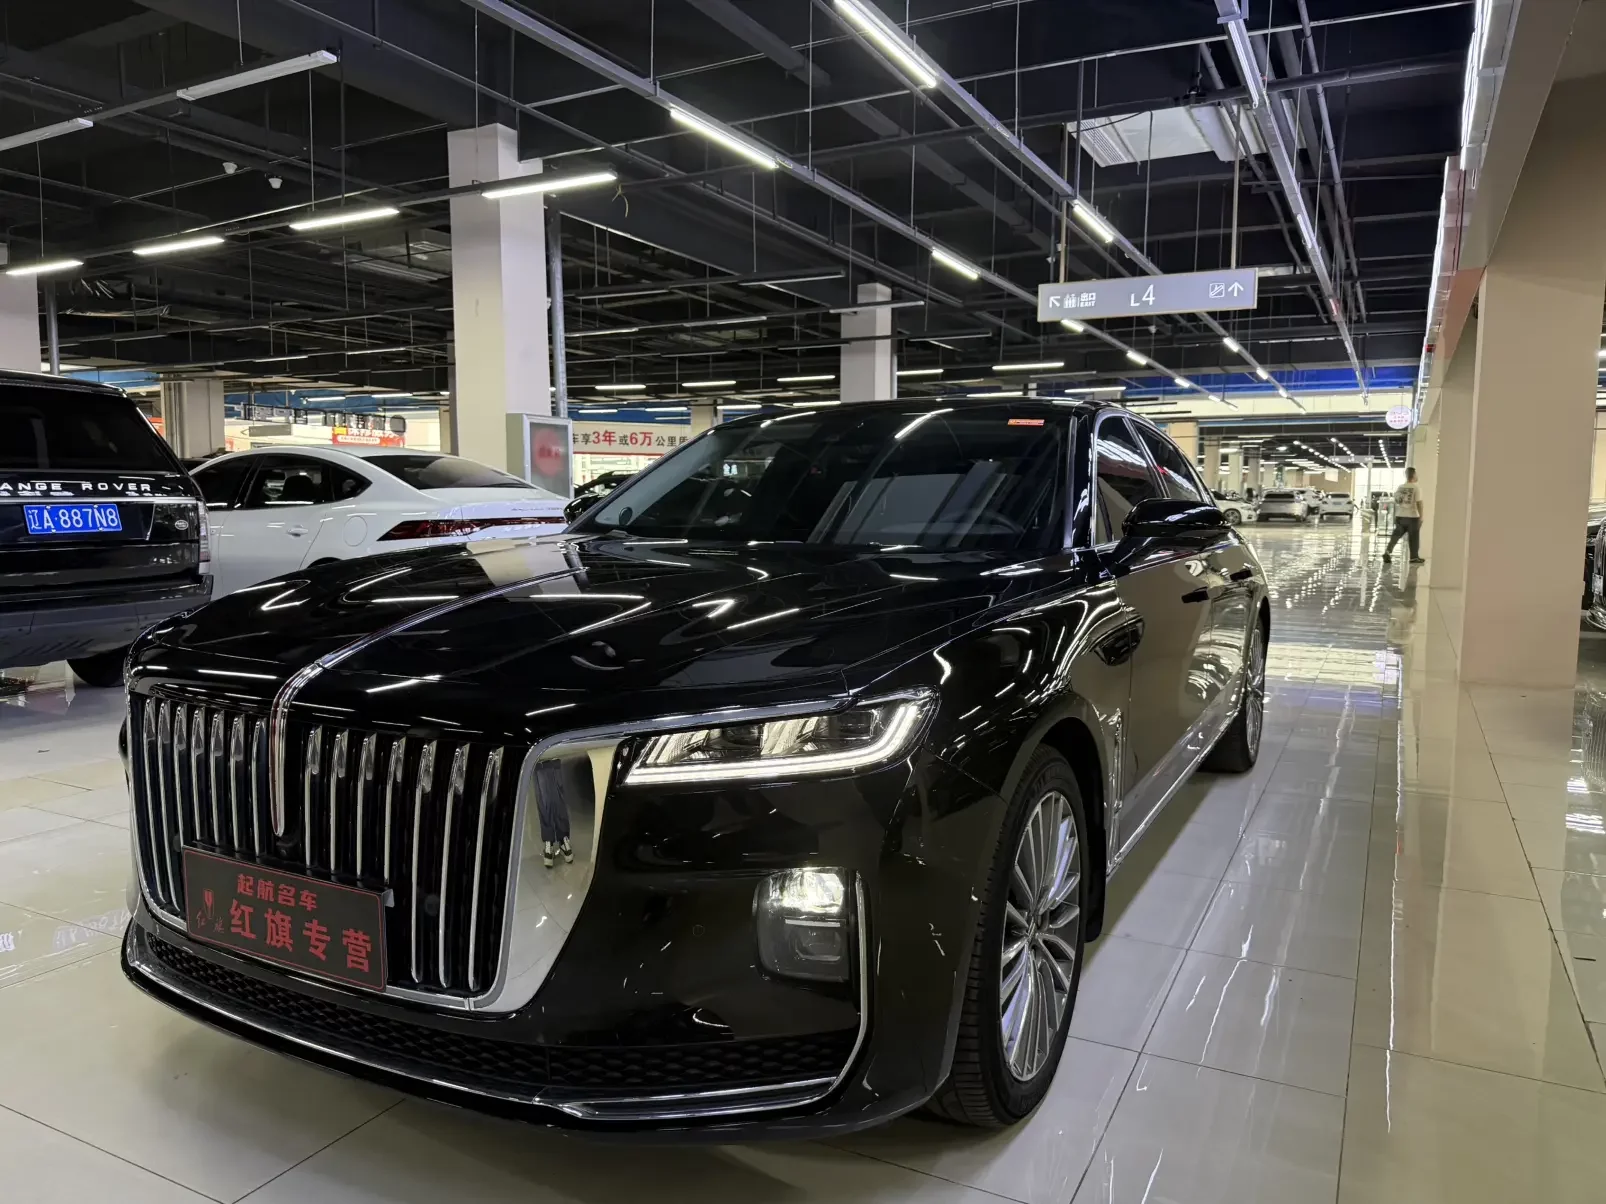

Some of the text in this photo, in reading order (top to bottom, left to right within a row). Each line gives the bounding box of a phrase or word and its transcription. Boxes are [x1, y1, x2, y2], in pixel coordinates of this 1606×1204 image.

[1080, 292, 1096, 301] 出口
[1130, 284, 1156, 306] L4
[82, 482, 152, 492] ROVER
[237, 874, 318, 912] 起航名车
[229, 899, 373, 973] 红旗专营
